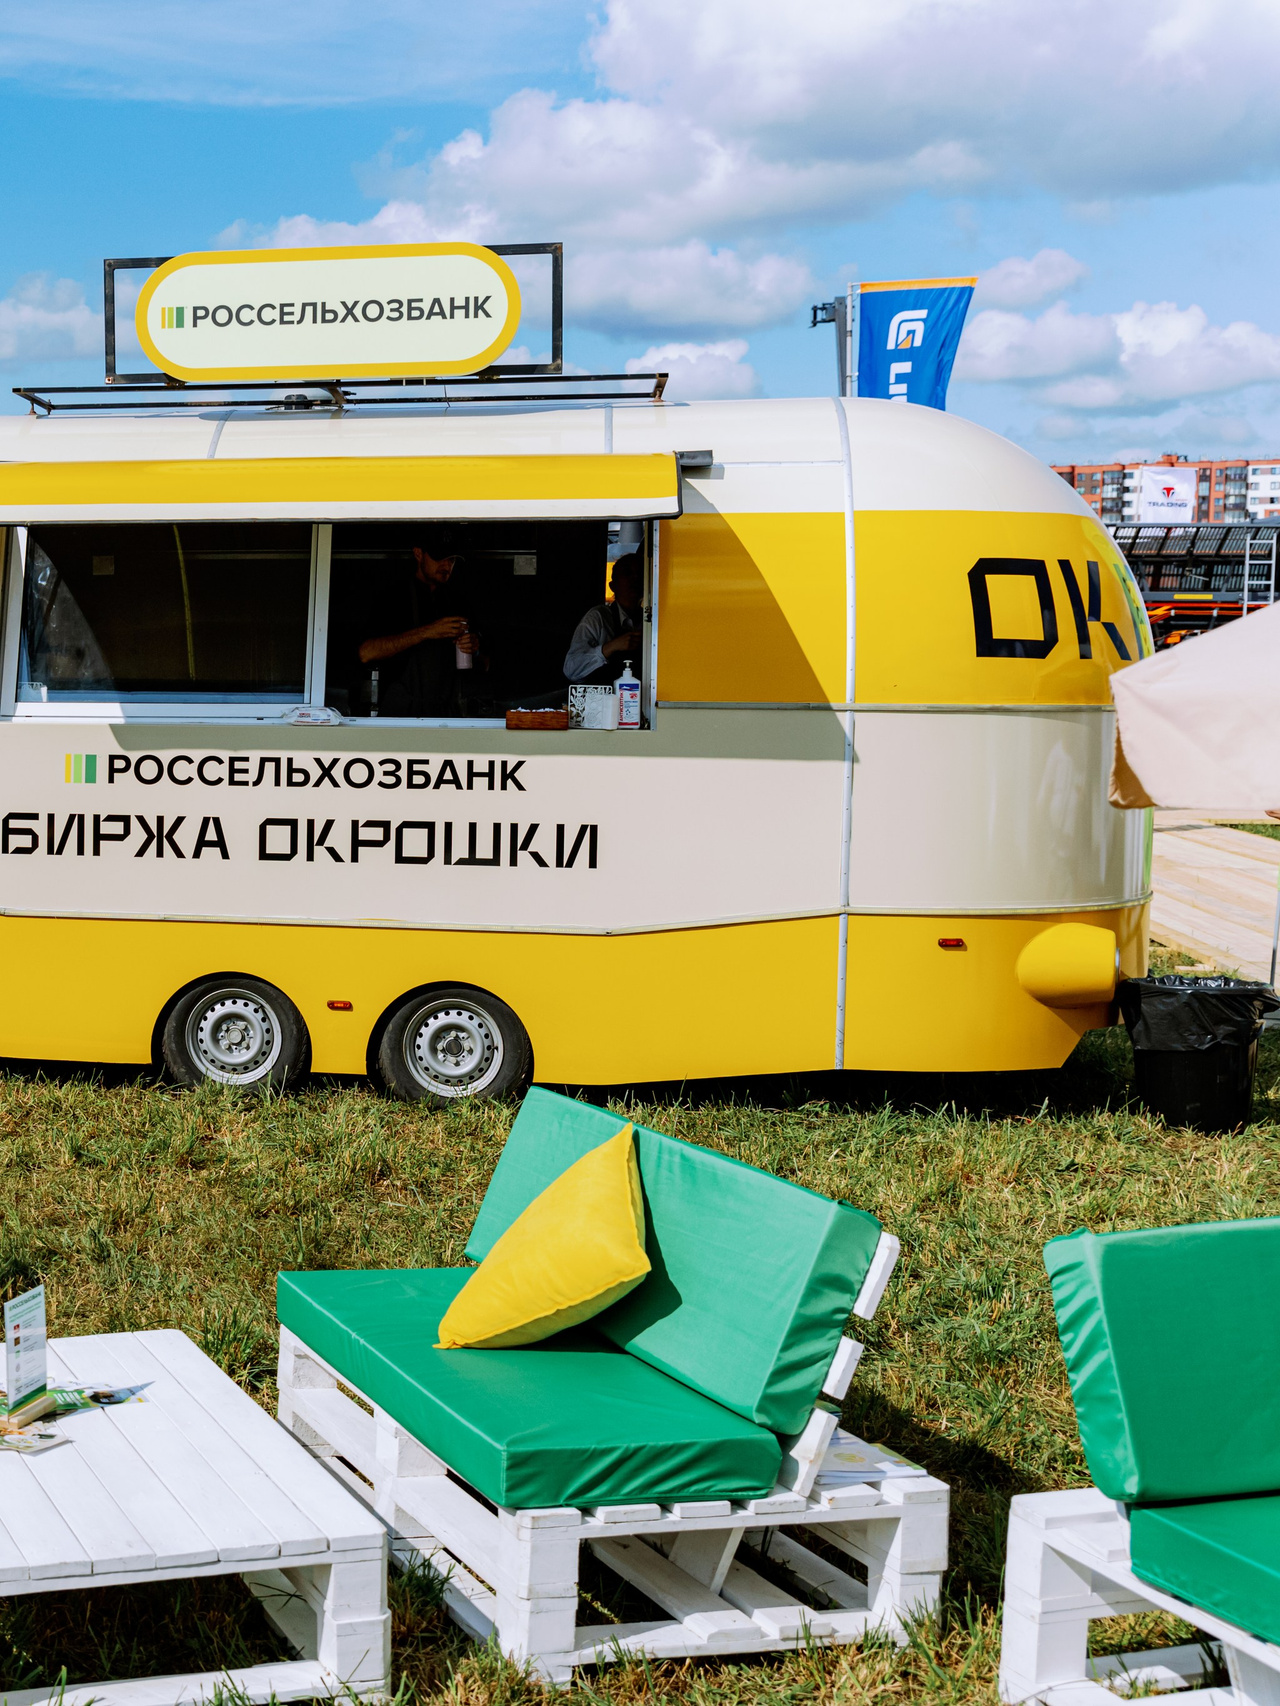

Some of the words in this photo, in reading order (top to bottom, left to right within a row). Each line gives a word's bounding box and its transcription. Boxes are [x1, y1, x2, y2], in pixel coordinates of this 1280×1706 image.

[192, 294, 493, 329] РОССЕЛЬХОЗБАНК
[107, 753, 527, 792] РОССЕЛЬХОЗБАНК
[1, 812, 230, 860] БИРЖА
[258, 817, 599, 869] ОКРОШКИ
